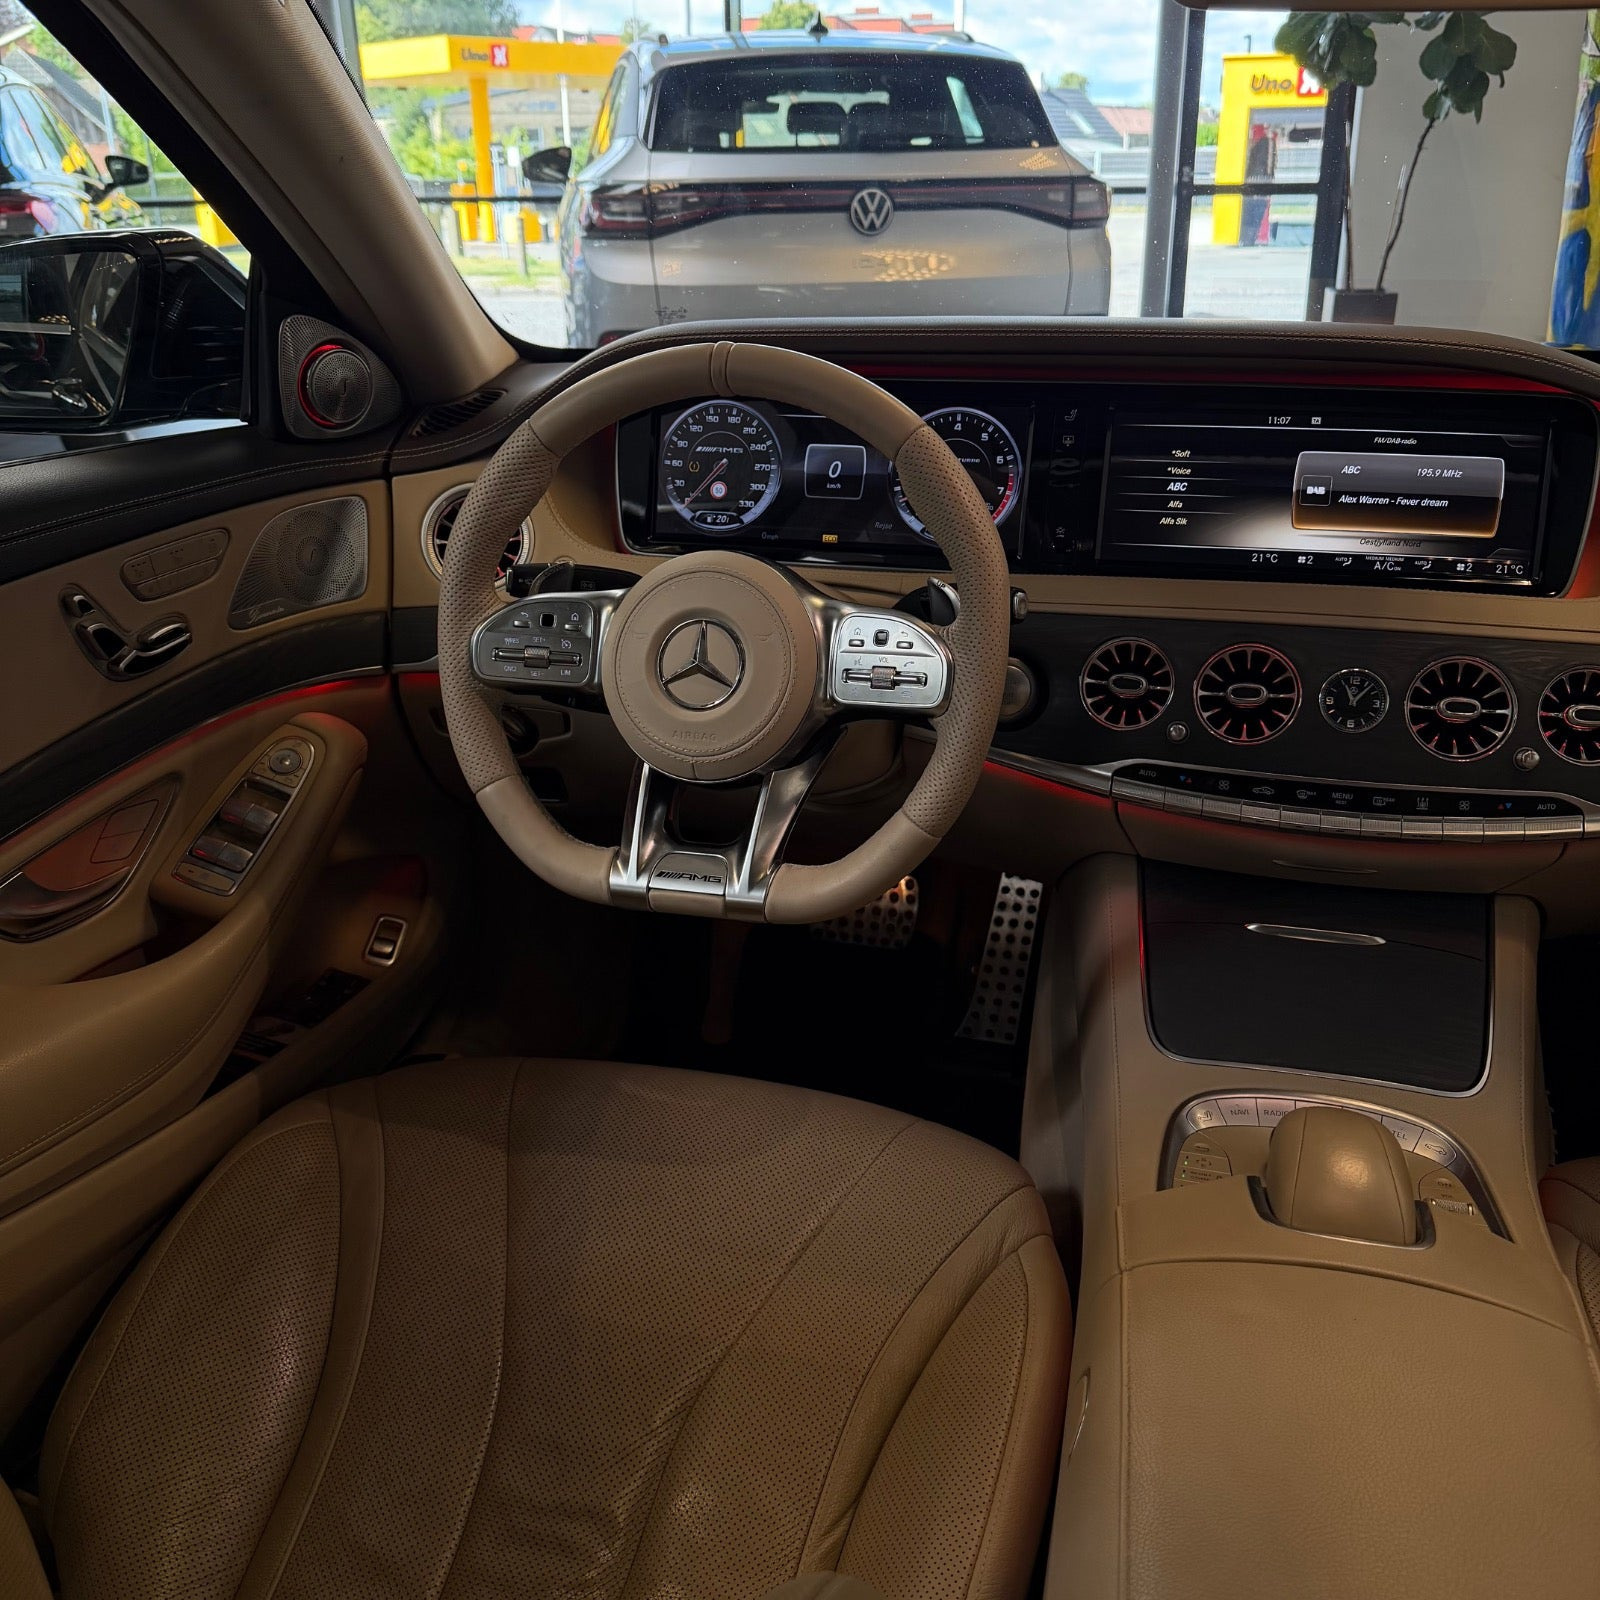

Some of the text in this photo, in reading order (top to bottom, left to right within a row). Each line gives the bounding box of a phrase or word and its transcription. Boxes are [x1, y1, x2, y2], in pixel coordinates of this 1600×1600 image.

[1251, 73, 1292, 92] Uno
[705, 415, 719, 423] 150
[727, 416, 741, 424] 180
[1267, 416, 1291, 425] 11:07
[689, 425, 703, 433] 120
[742, 427, 757, 435] 210
[953, 422, 962, 431] 4
[981, 433, 989, 441] 5
[677, 440, 689, 448] 90
[996, 456, 1004, 464] 6
[754, 463, 771, 471] 270
[828, 460, 842, 479] 0
[1341, 465, 1361, 475] ABC
[1416, 468, 1463, 478] 195.9 MHz
[749, 483, 766, 491] 300
[997, 486, 1004, 495] 7
[1166, 482, 1188, 492] ABC
[1306, 486, 1326, 495] DAB
[738, 500, 755, 508] 330
[1167, 500, 1183, 509] Alfa
[1338, 494, 1357, 504] Alex
[1358, 494, 1389, 505] Warren
[1396, 497, 1420, 507] Fever
[1421, 498, 1449, 508] dream
[1159, 517, 1175, 526] Alfa
[1402, 539, 1422, 548] Nord
[1251, 553, 1279, 563] 21°C
[1306, 556, 1314, 565] 2
[1373, 561, 1395, 571] A/C
[1465, 563, 1473, 572] 2
[1495, 564, 1525, 575] 21°C
[1350, 676, 1361, 685] 12
[1325, 696, 1334, 705] 9
[1372, 700, 1380, 708] 3
[1347, 719, 1355, 728] 6
[672, 730, 718, 742] AIRBAG
[1138, 769, 1157, 778] AUTO
[1331, 792, 1354, 800] MENU
